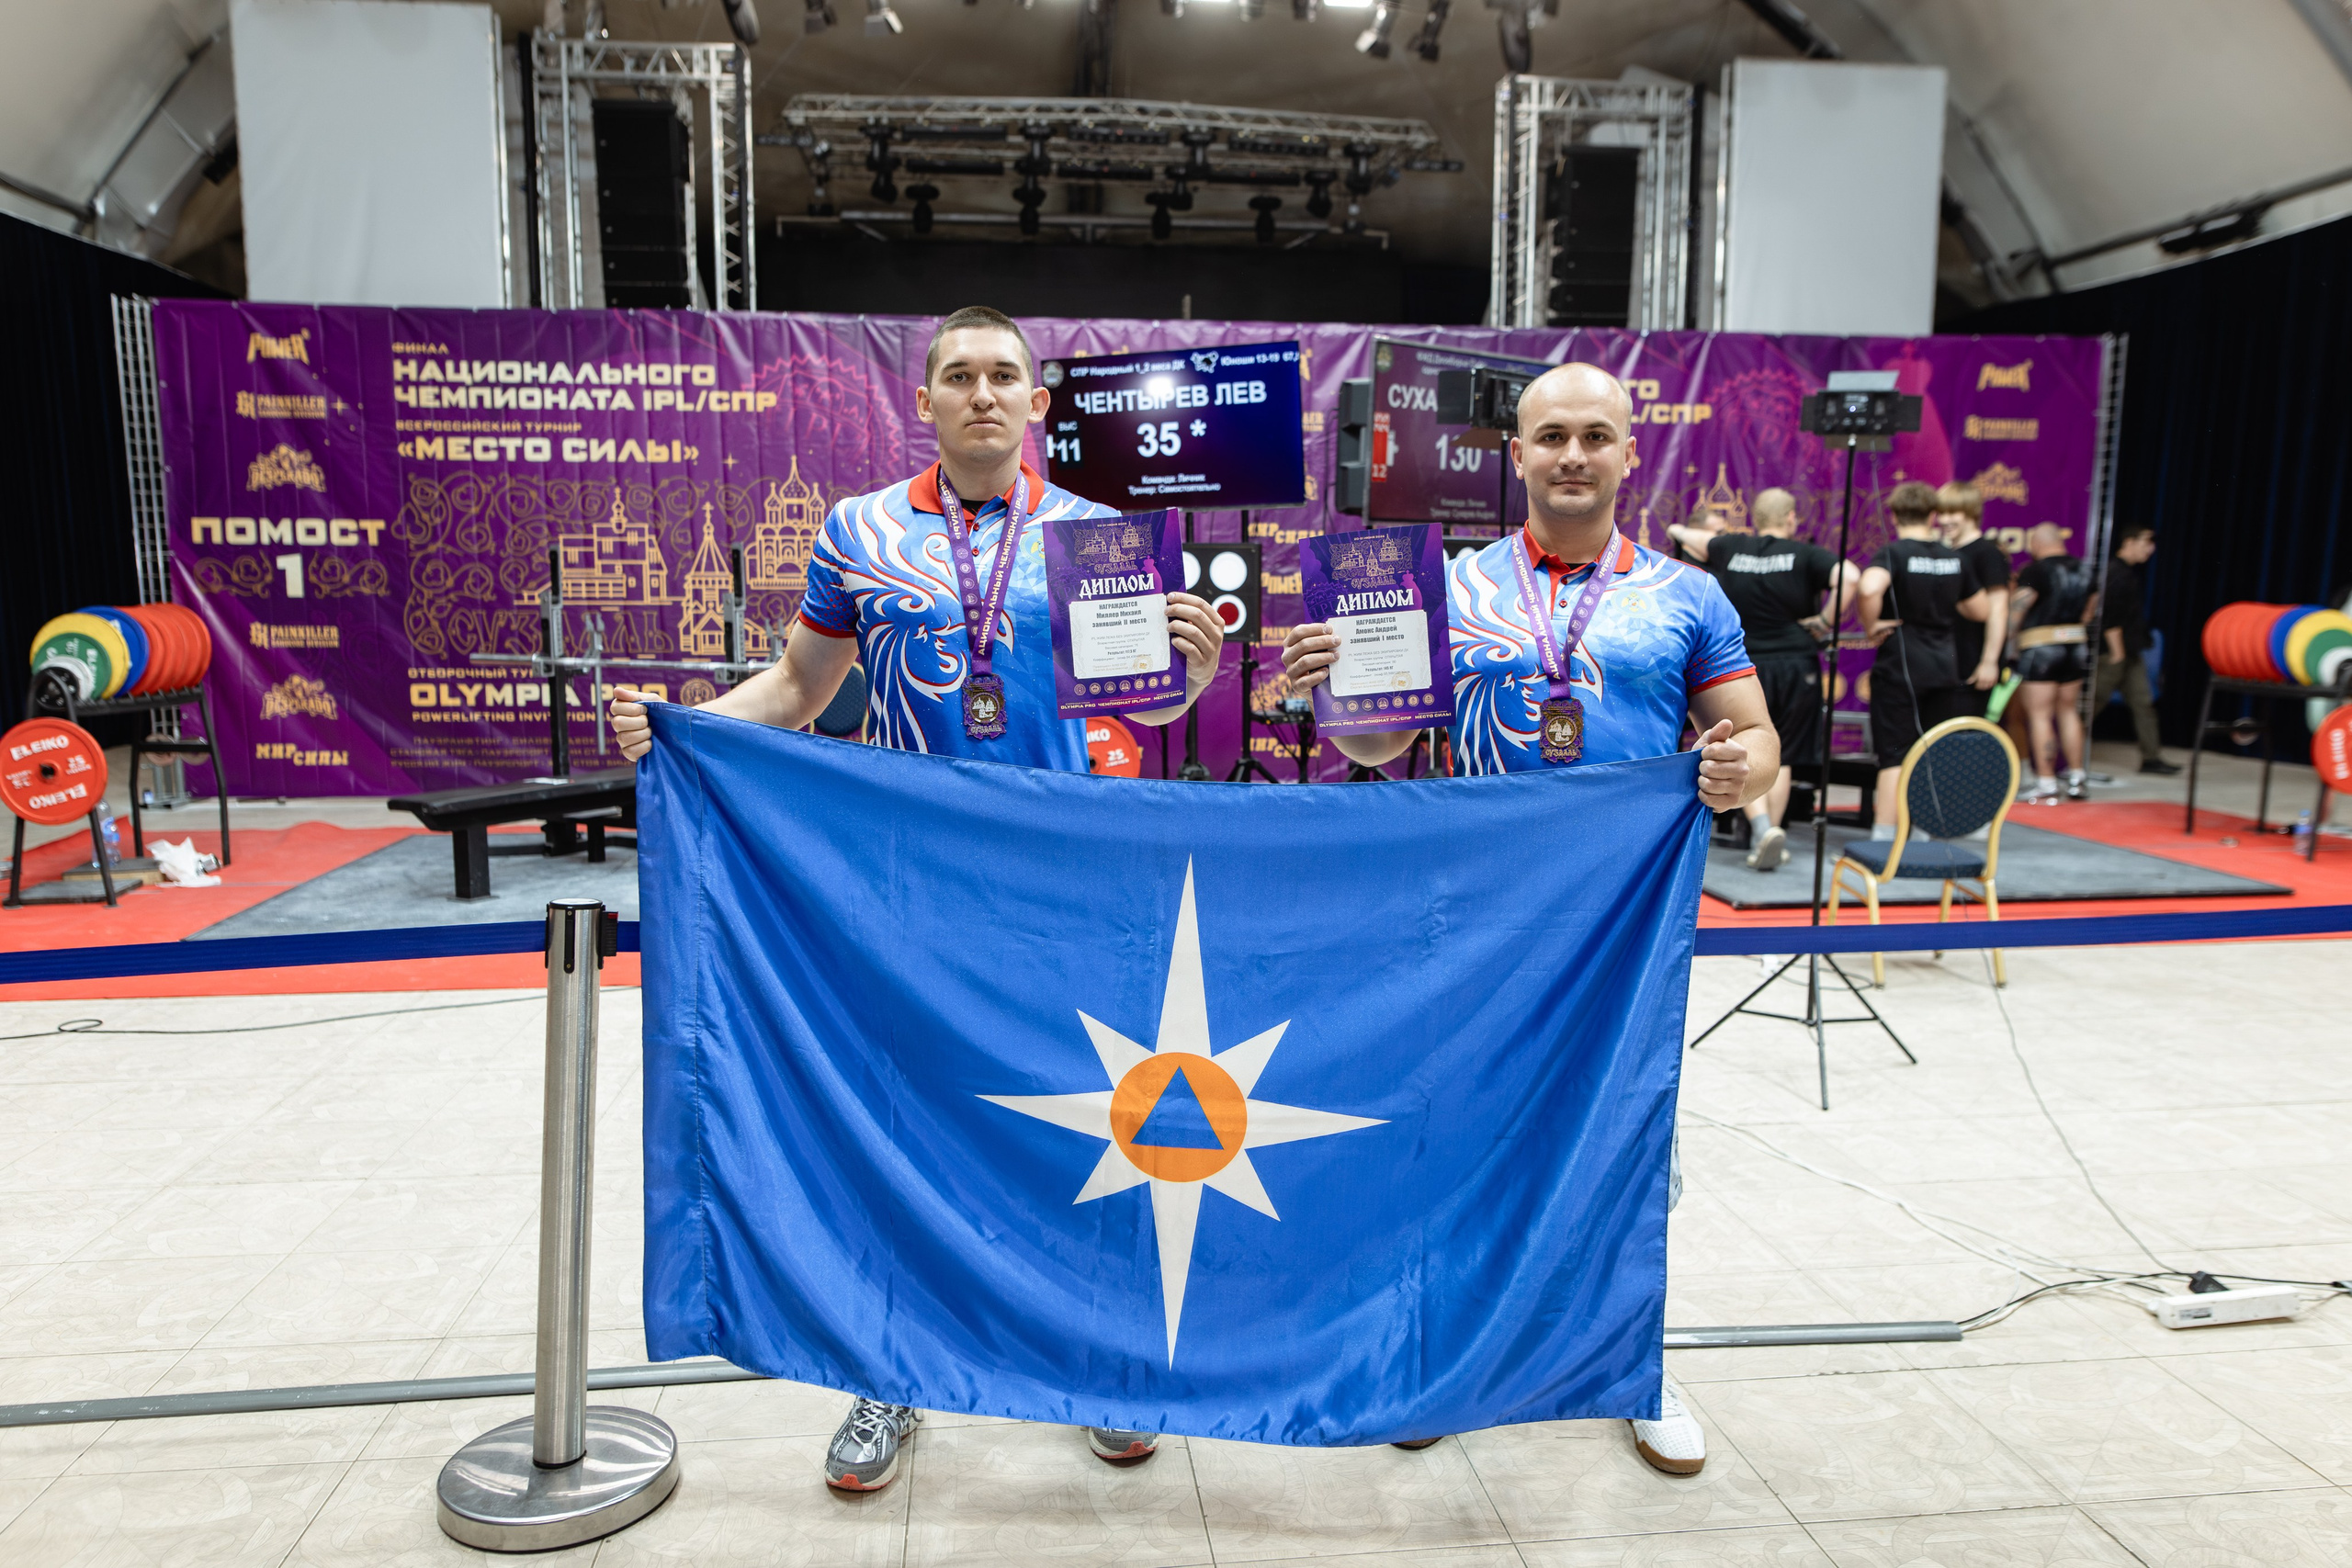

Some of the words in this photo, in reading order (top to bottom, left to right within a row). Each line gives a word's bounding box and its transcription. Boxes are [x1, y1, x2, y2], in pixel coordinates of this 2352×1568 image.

[391, 343, 448, 355] ФИНАЛ
[393, 359, 716, 386] НАЦИОНАЛЬНОГО
[394, 386, 636, 411] ЧЕМПИОНАТА
[643, 389, 777, 412] IPL/СПР
[1074, 384, 1209, 414] ЧЕНТЫРЕВ
[1215, 380, 1267, 406] ЛЕВ
[1387, 383, 1438, 412] СУХА
[395, 419, 522, 432] ВСЕРОССИЙСКИЙ
[525, 422, 582, 433] ТУРНИР
[1631, 402, 1713, 425] /СПР
[397, 435, 551, 462] «МЕСТО
[562, 437, 699, 463] СИЛЫ»
[1136, 422, 1182, 457] 35
[191, 517, 386, 546] ПОМОСТ
[949, 505, 962, 540] СИЛЫ»
[276, 553, 303, 598] 1
[978, 570, 1004, 656] АЦИОНАЛЬНЫЙ
[999, 510, 1020, 569] ЧЕМПИОНАТ
[1079, 573, 1155, 600] ДИПЛОМ
[1516, 556, 1535, 604] ЧЕМПИОНАТ
[1099, 601, 1138, 610] НАГРАЖДАЕТСЯ
[1335, 589, 1414, 615] ДИПЛОМ
[1356, 616, 1396, 626] НАГРАЖДАЕТСЯ
[1375, 625, 1397, 633] Андрей
[1350, 635, 1380, 644] занявший
[1531, 604, 1561, 680] АЦИОНАЛЬНЫЙ
[408, 666, 507, 679] ОТБОРОЧНЫЙ
[412, 712, 514, 723] POWERLIFTING
[10, 735, 69, 761] ELEIKO
[255, 742, 297, 759] МИР
[293, 750, 349, 766] СИЛЫ
[1250, 738, 1278, 751] ИР
[28, 783, 87, 809] ELEIKO
